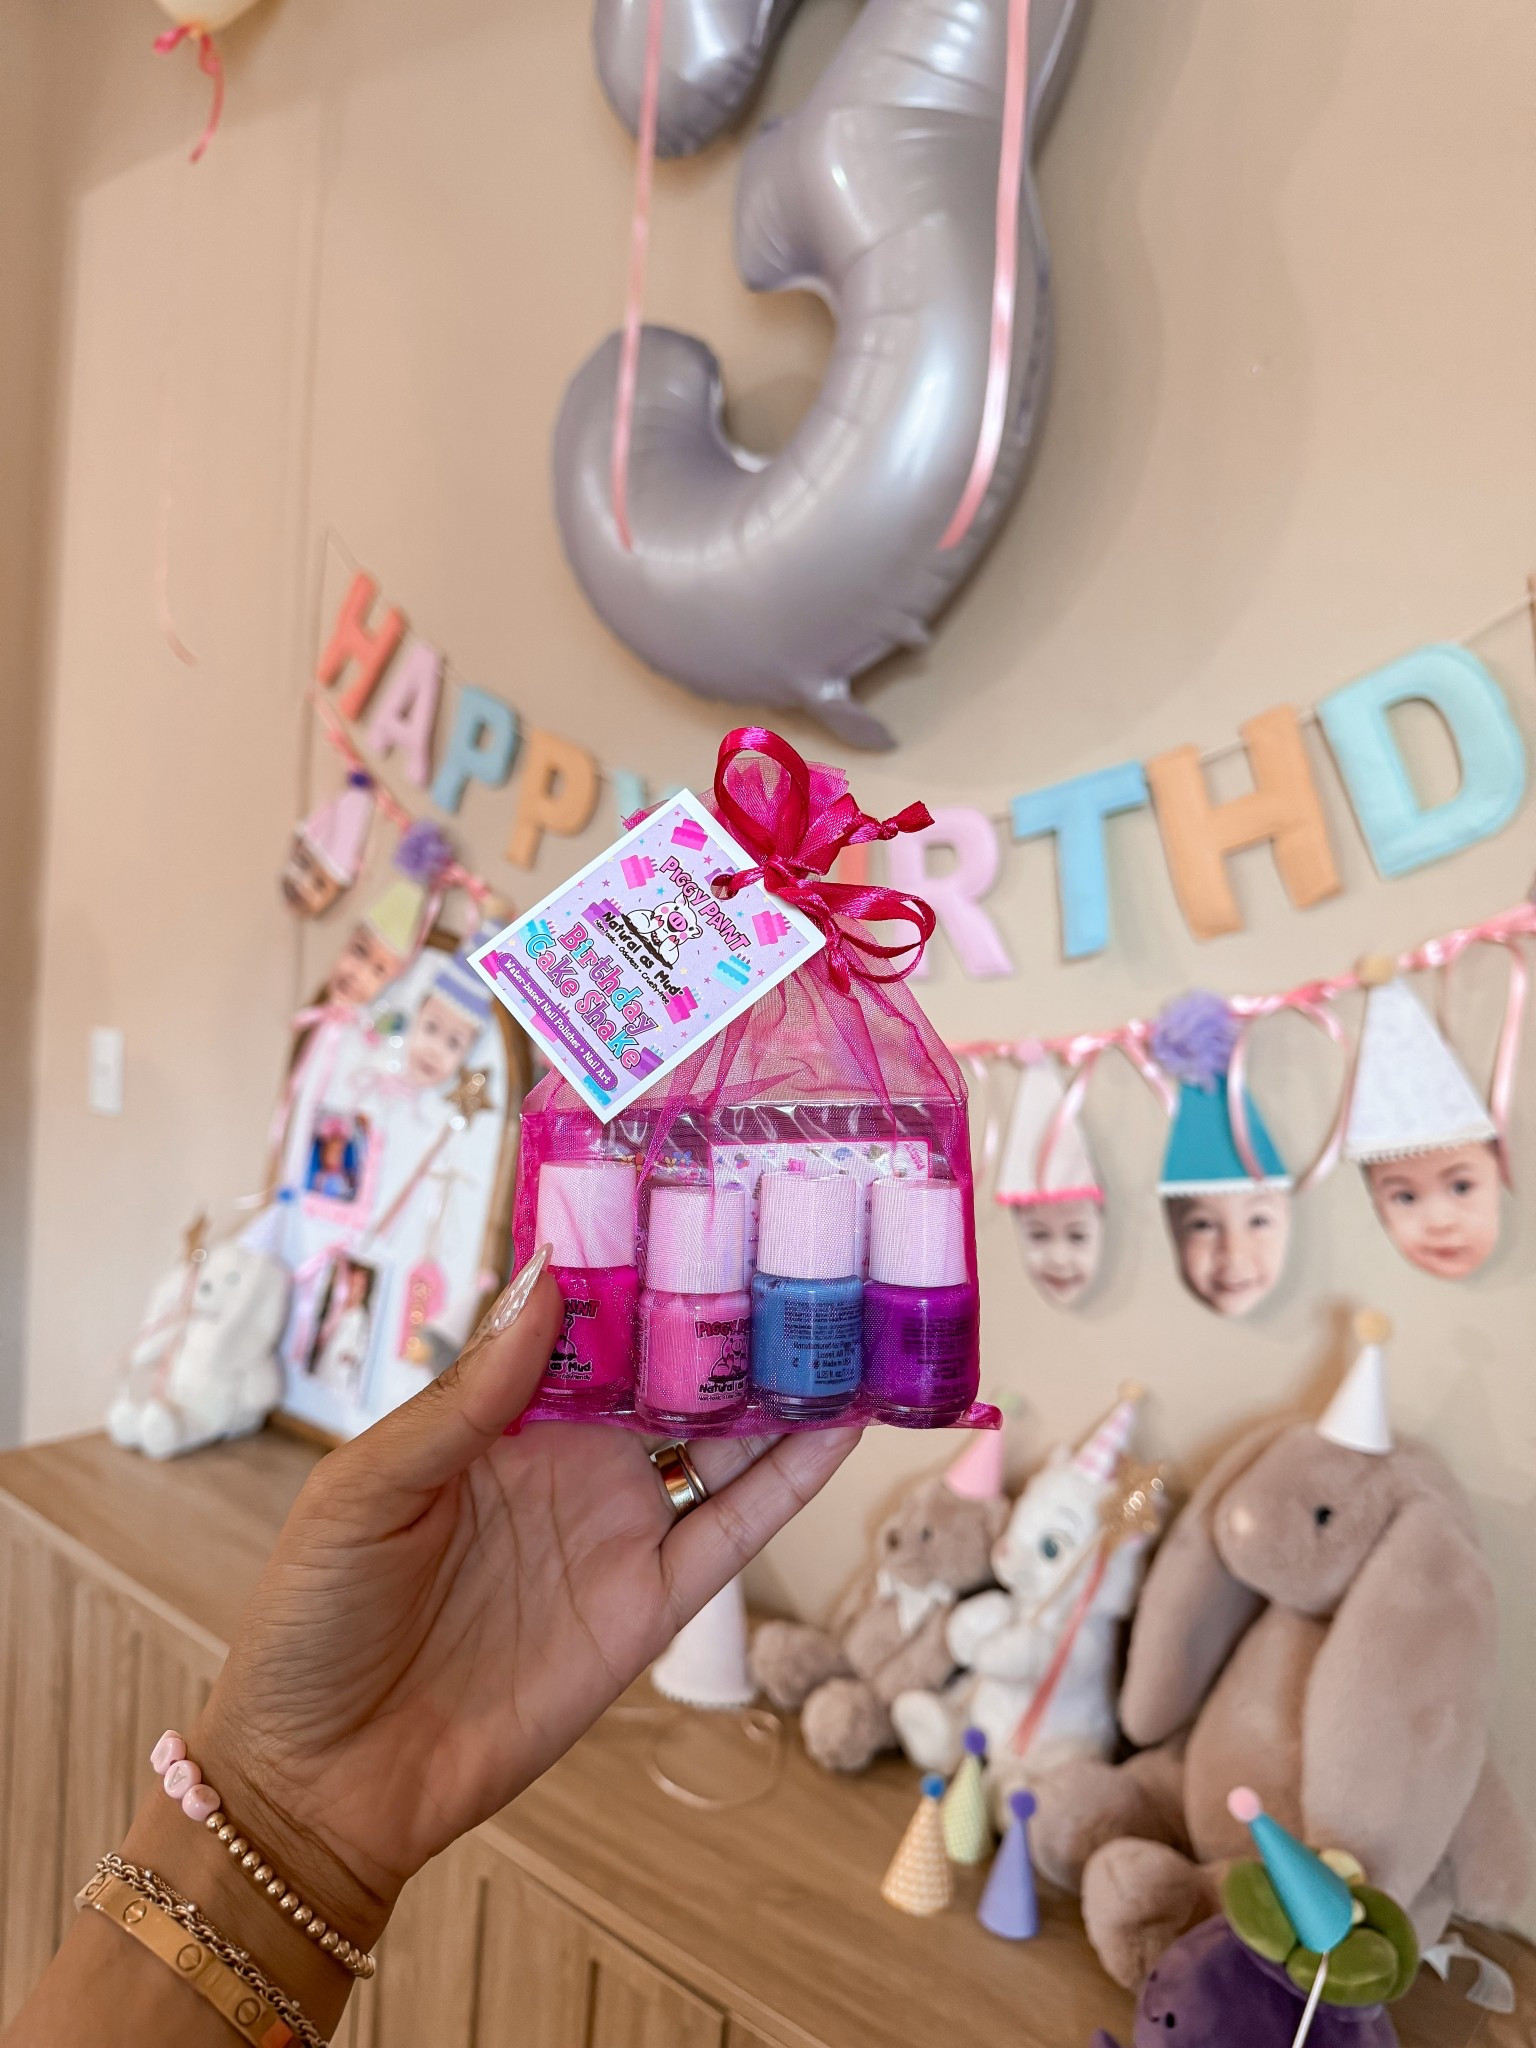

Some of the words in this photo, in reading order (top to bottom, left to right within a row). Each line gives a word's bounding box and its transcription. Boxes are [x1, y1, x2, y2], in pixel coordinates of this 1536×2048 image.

[602, 911, 642, 953] Natural
[640, 955, 655, 969] as
[659, 855, 711, 906] PIGGY
[698, 901, 752, 951] PAINT
[558, 922, 659, 1036] Birthday
[619, 946, 639, 969] Odorless
[504, 959, 545, 1005] Water-based
[541, 1002, 558, 1021] Nail
[554, 1019, 581, 1049] Polishes
[583, 1051, 600, 1070] Nail
[596, 1068, 612, 1085] Art
[699, 1380, 734, 1393] Natural
